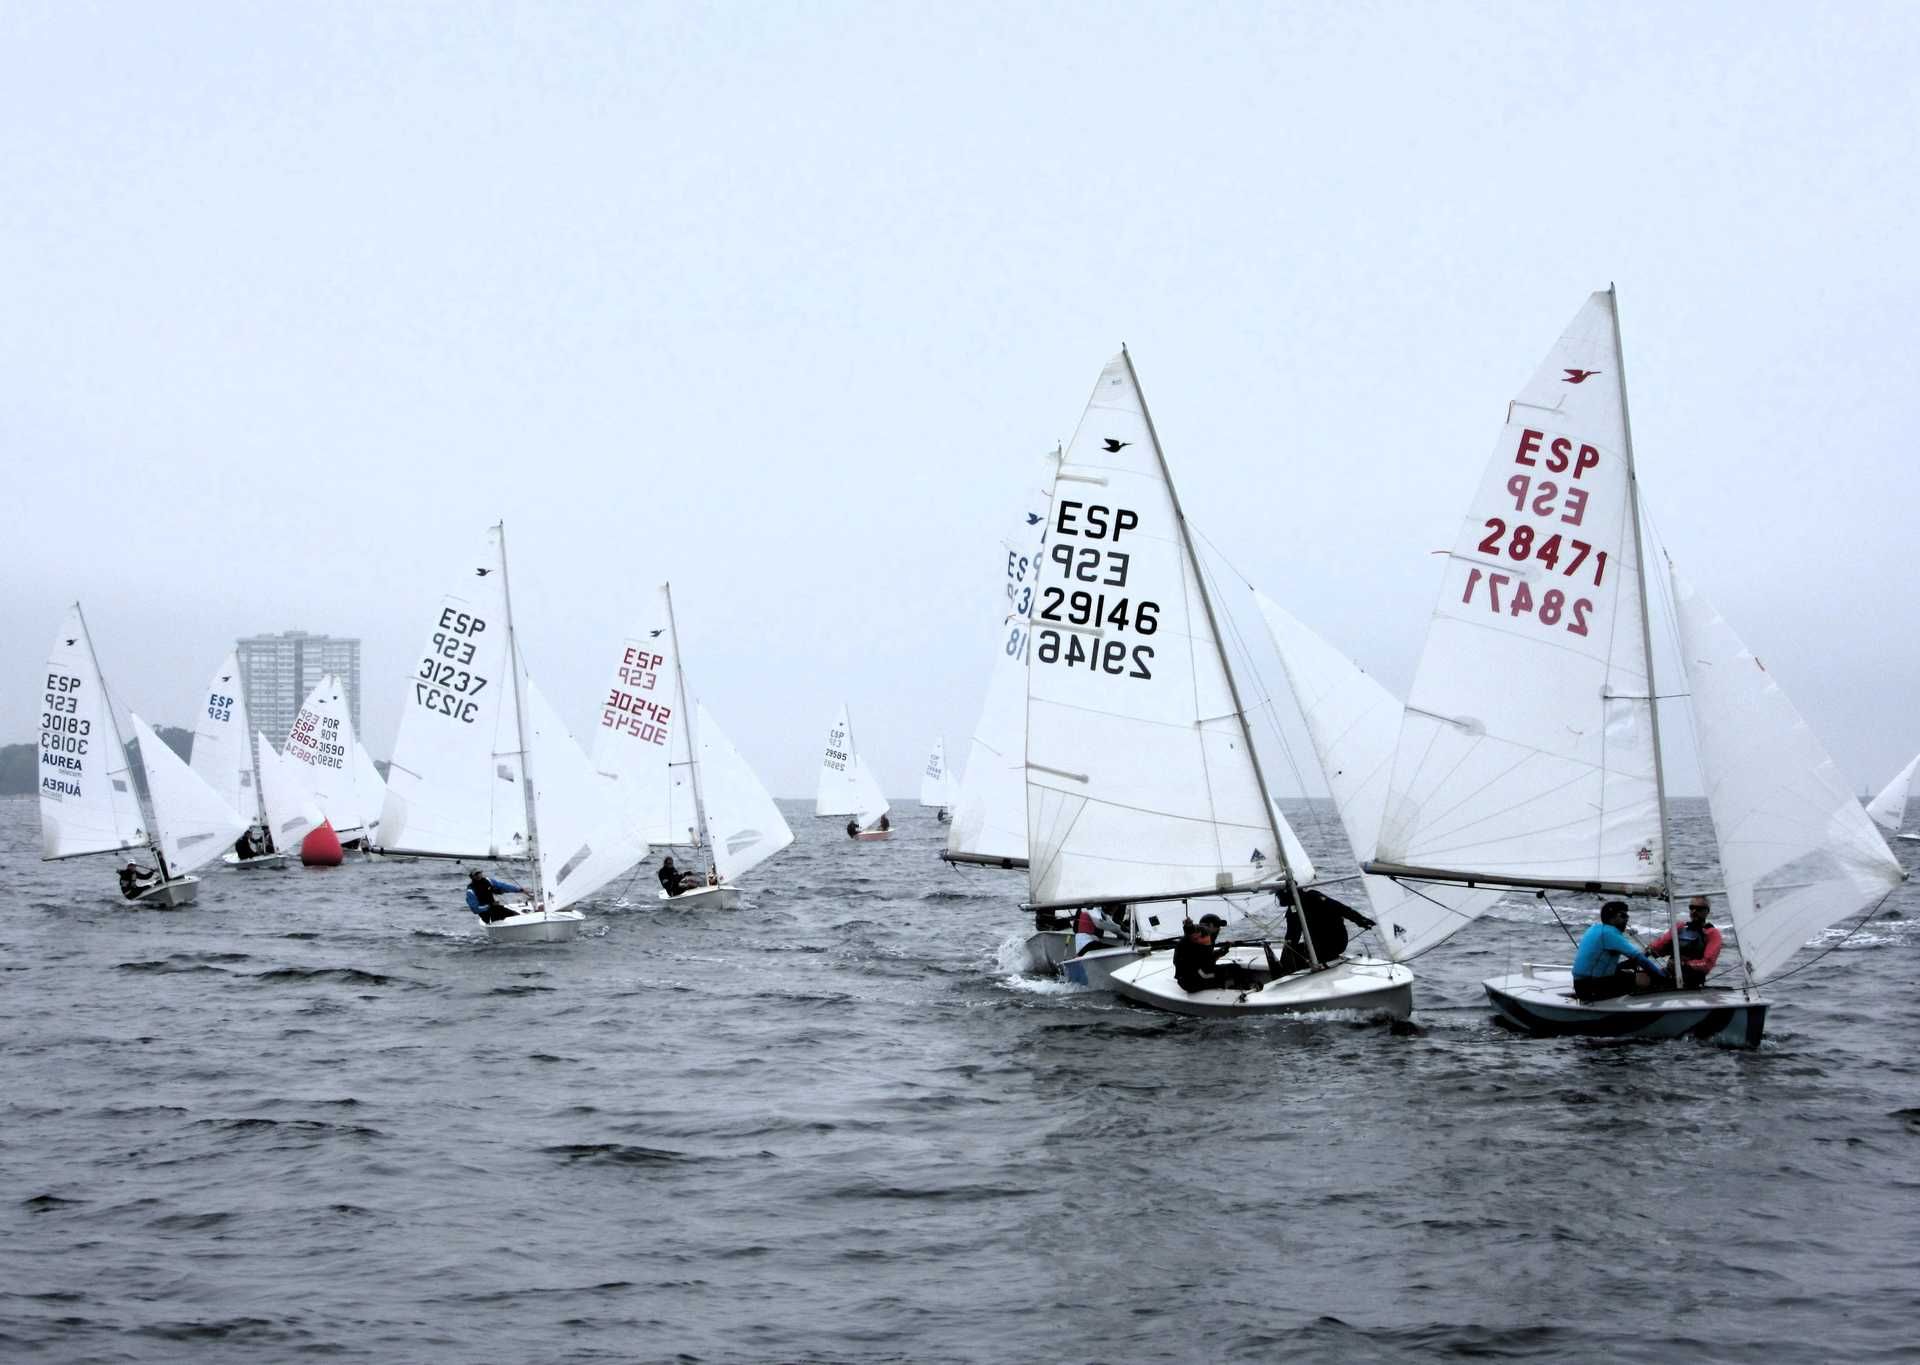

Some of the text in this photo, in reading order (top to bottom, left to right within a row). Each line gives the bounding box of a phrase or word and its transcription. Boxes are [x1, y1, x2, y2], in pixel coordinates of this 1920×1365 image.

[1515, 428, 1600, 480] ESP
[1056, 500, 1139, 542] ESP
[1008, 551, 1029, 583] ES
[1478, 517, 1608, 587] 28471
[439, 607, 487, 638] ESP
[1041, 586, 1161, 636] 29146
[623, 647, 664, 671] ESP
[47, 674, 81, 693] ESP
[420, 658, 488, 696] 31237
[210, 694, 234, 708] ESP
[607, 688, 671, 725] 30242
[42, 713, 91, 736] 30183
[290, 729, 318, 749] 2863
[295, 718, 315, 733] ESP
[322, 717, 340, 730] POR
